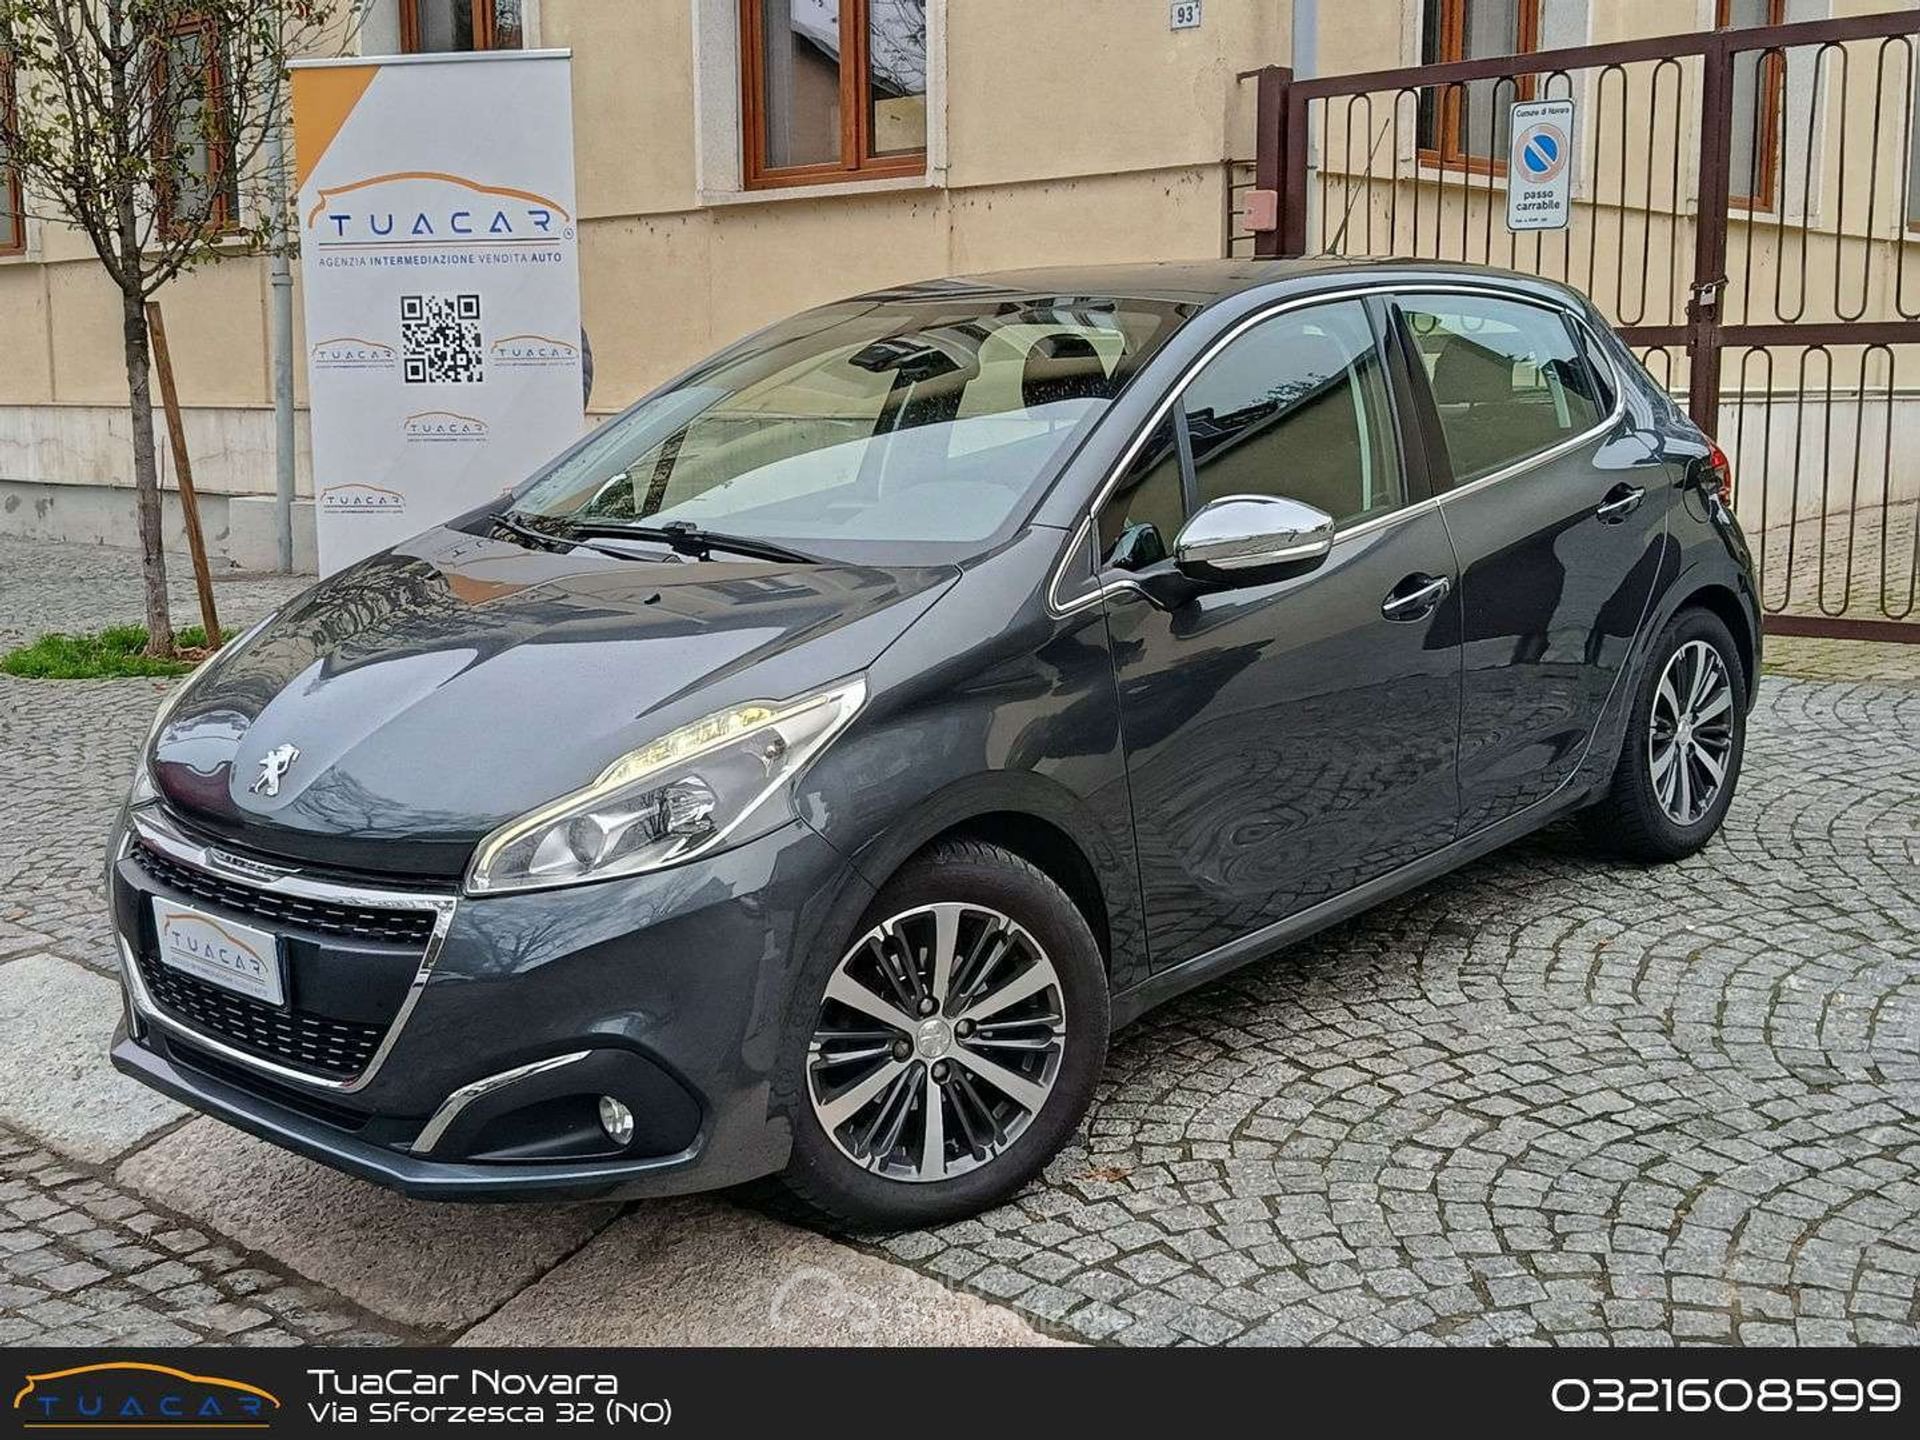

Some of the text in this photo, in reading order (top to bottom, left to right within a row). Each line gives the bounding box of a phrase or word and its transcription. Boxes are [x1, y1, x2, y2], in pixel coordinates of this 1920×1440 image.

[1177, 6, 1193, 24] 93
[1523, 190, 1554, 201] passo
[1515, 200, 1560, 211] carrabile
[329, 210, 551, 237] TUACAR
[318, 252, 562, 268] AGENZIA INTERMEDIAZIONE VENDITA AUTO
[318, 349, 392, 360] TUACAR
[498, 347, 572, 357] TUACAR
[410, 423, 484, 434] TUACAR
[327, 495, 400, 505] TUACAR
[171, 930, 260, 974] TUACAR
